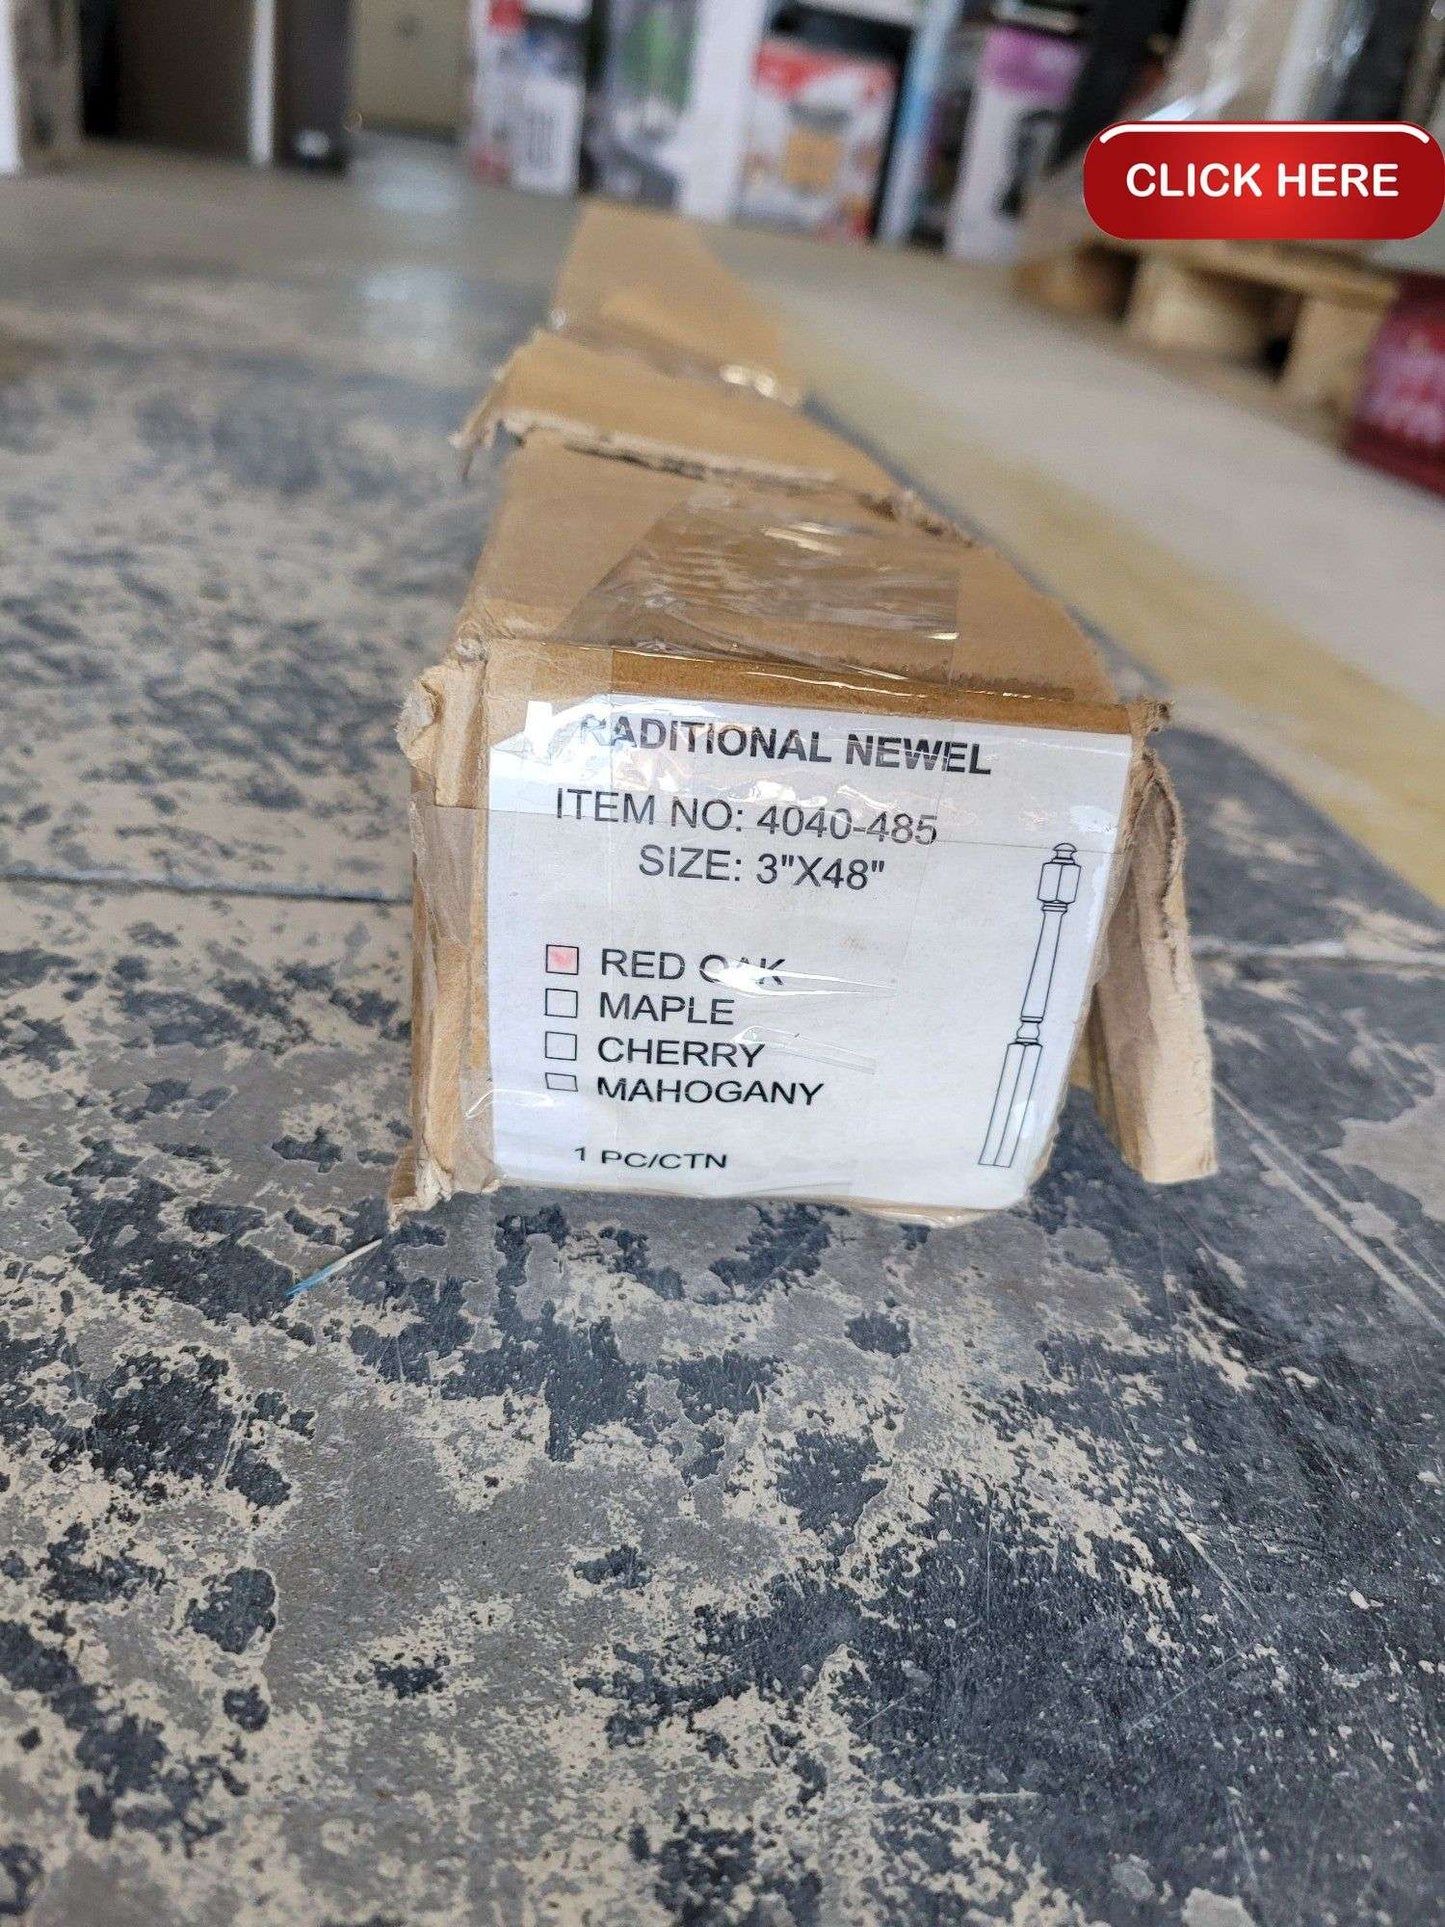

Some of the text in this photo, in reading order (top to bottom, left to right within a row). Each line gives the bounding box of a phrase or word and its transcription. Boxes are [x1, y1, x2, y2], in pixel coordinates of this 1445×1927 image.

[579, 714, 992, 775] RADITIONAL NEWEL
[555, 787, 938, 847] ITEM NO: 4040-485
[638, 843, 885, 890] SIZE: 3"X48"
[601, 948, 786, 986] RED OK
[599, 991, 735, 1025] MAPLE
[597, 1036, 765, 1068] CHERRY
[597, 1076, 824, 1106] MAHOGANY
[573, 1146, 728, 1169] 1 PC/CTN
